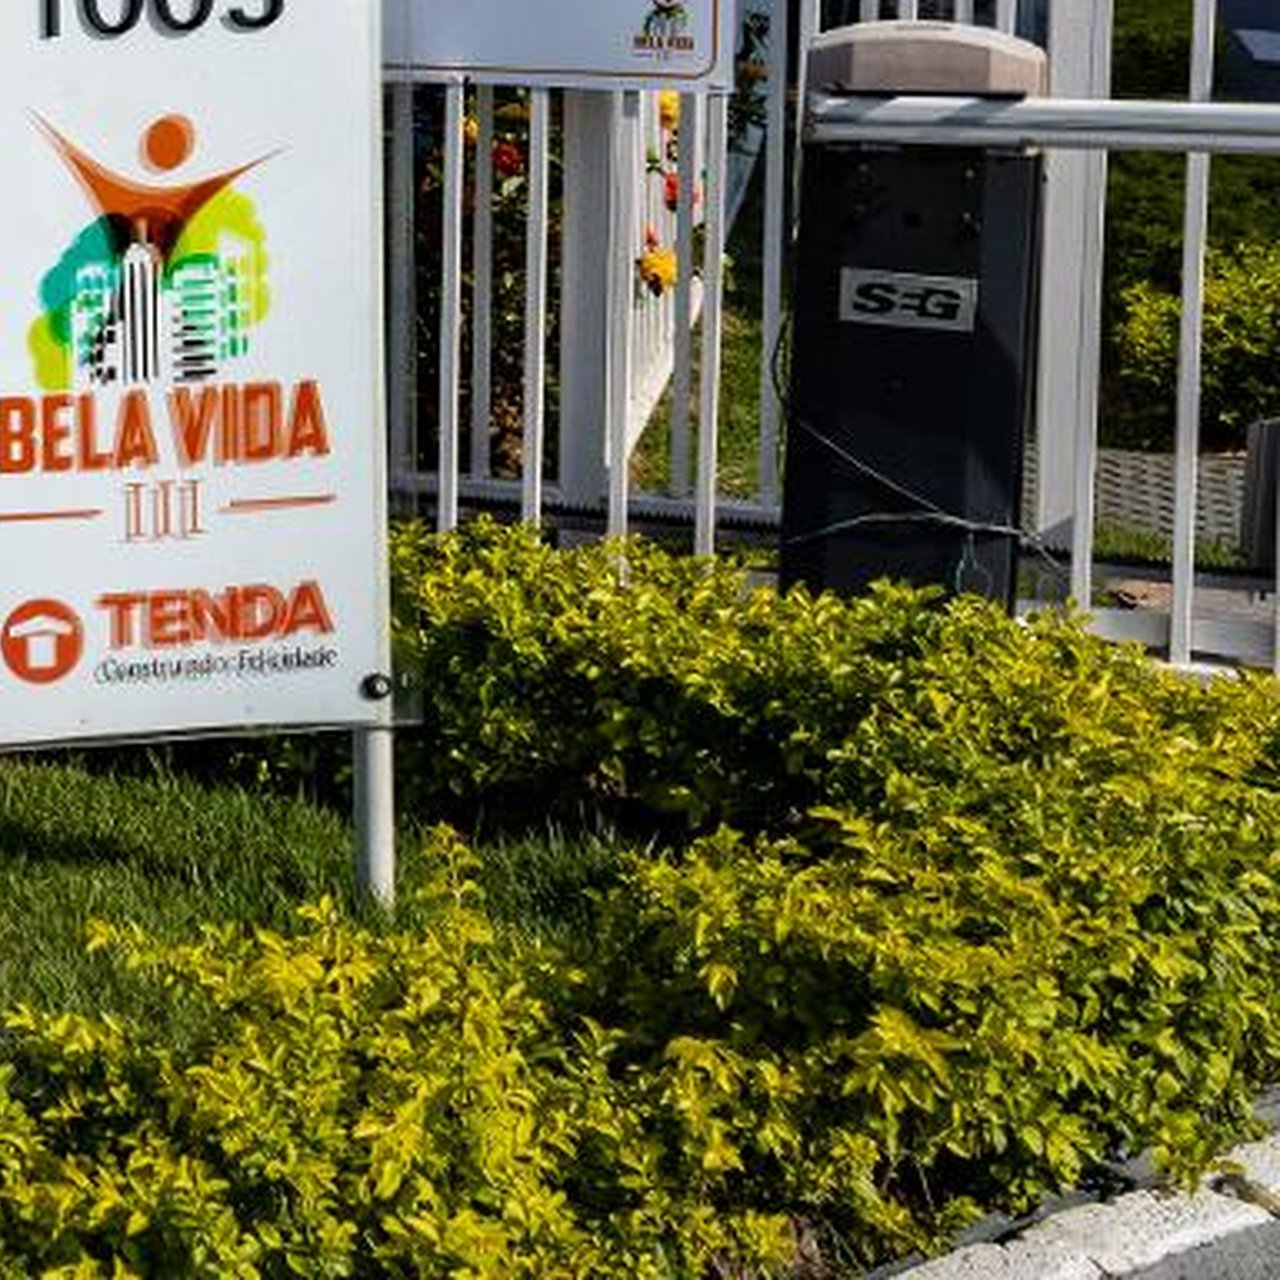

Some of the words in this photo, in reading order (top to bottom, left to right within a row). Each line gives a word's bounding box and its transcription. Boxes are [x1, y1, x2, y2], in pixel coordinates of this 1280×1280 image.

[167, 379, 331, 468] VIDA
[121, 478, 208, 542] III
[96, 580, 336, 649] TENDA
